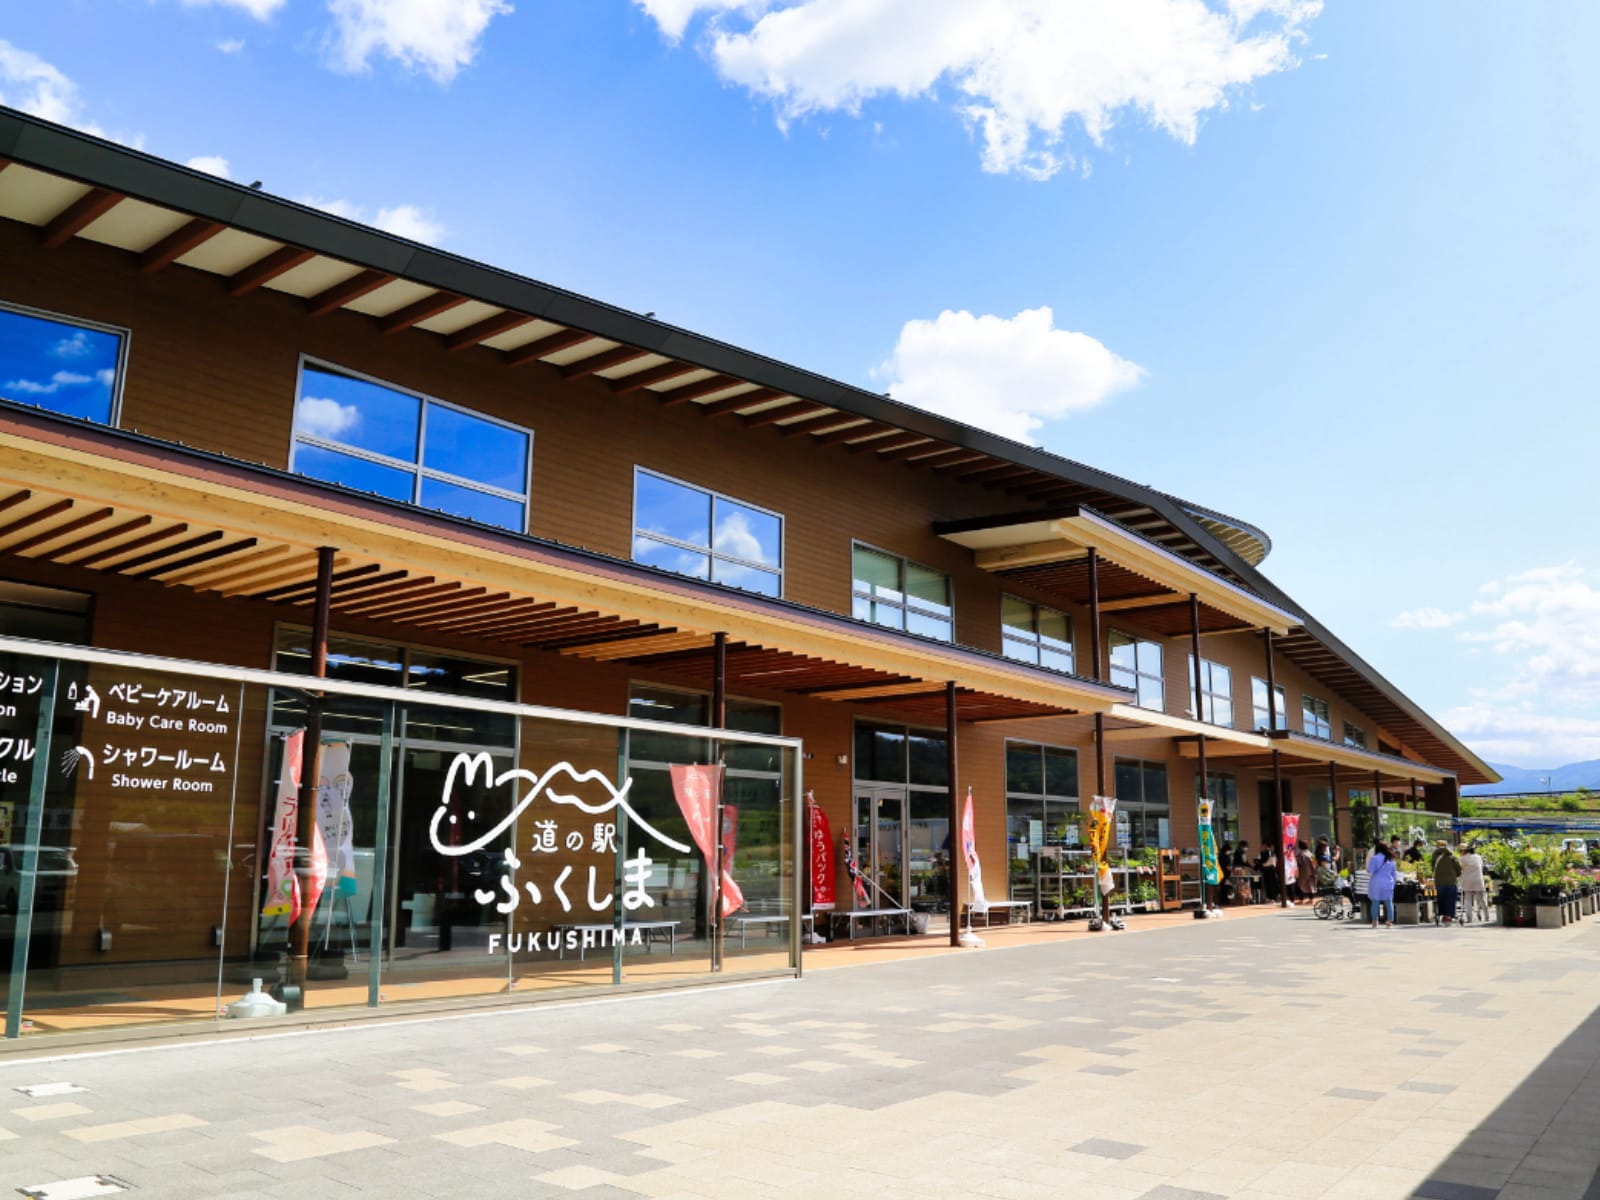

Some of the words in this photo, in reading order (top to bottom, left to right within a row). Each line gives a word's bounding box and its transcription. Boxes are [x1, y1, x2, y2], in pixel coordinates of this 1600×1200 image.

[108, 683, 230, 713] ベビーケアルーム
[106, 711, 144, 730] Baby
[150, 715, 183, 731] Care
[188, 719, 228, 734] Room
[103, 743, 226, 772] シャワールーム
[112, 773, 168, 790] Shower
[173, 777, 213, 792] Room
[532, 819, 618, 853] 道の駅
[474, 847, 655, 913] ふくしま
[488, 927, 643, 954] FUKUSHIMA
